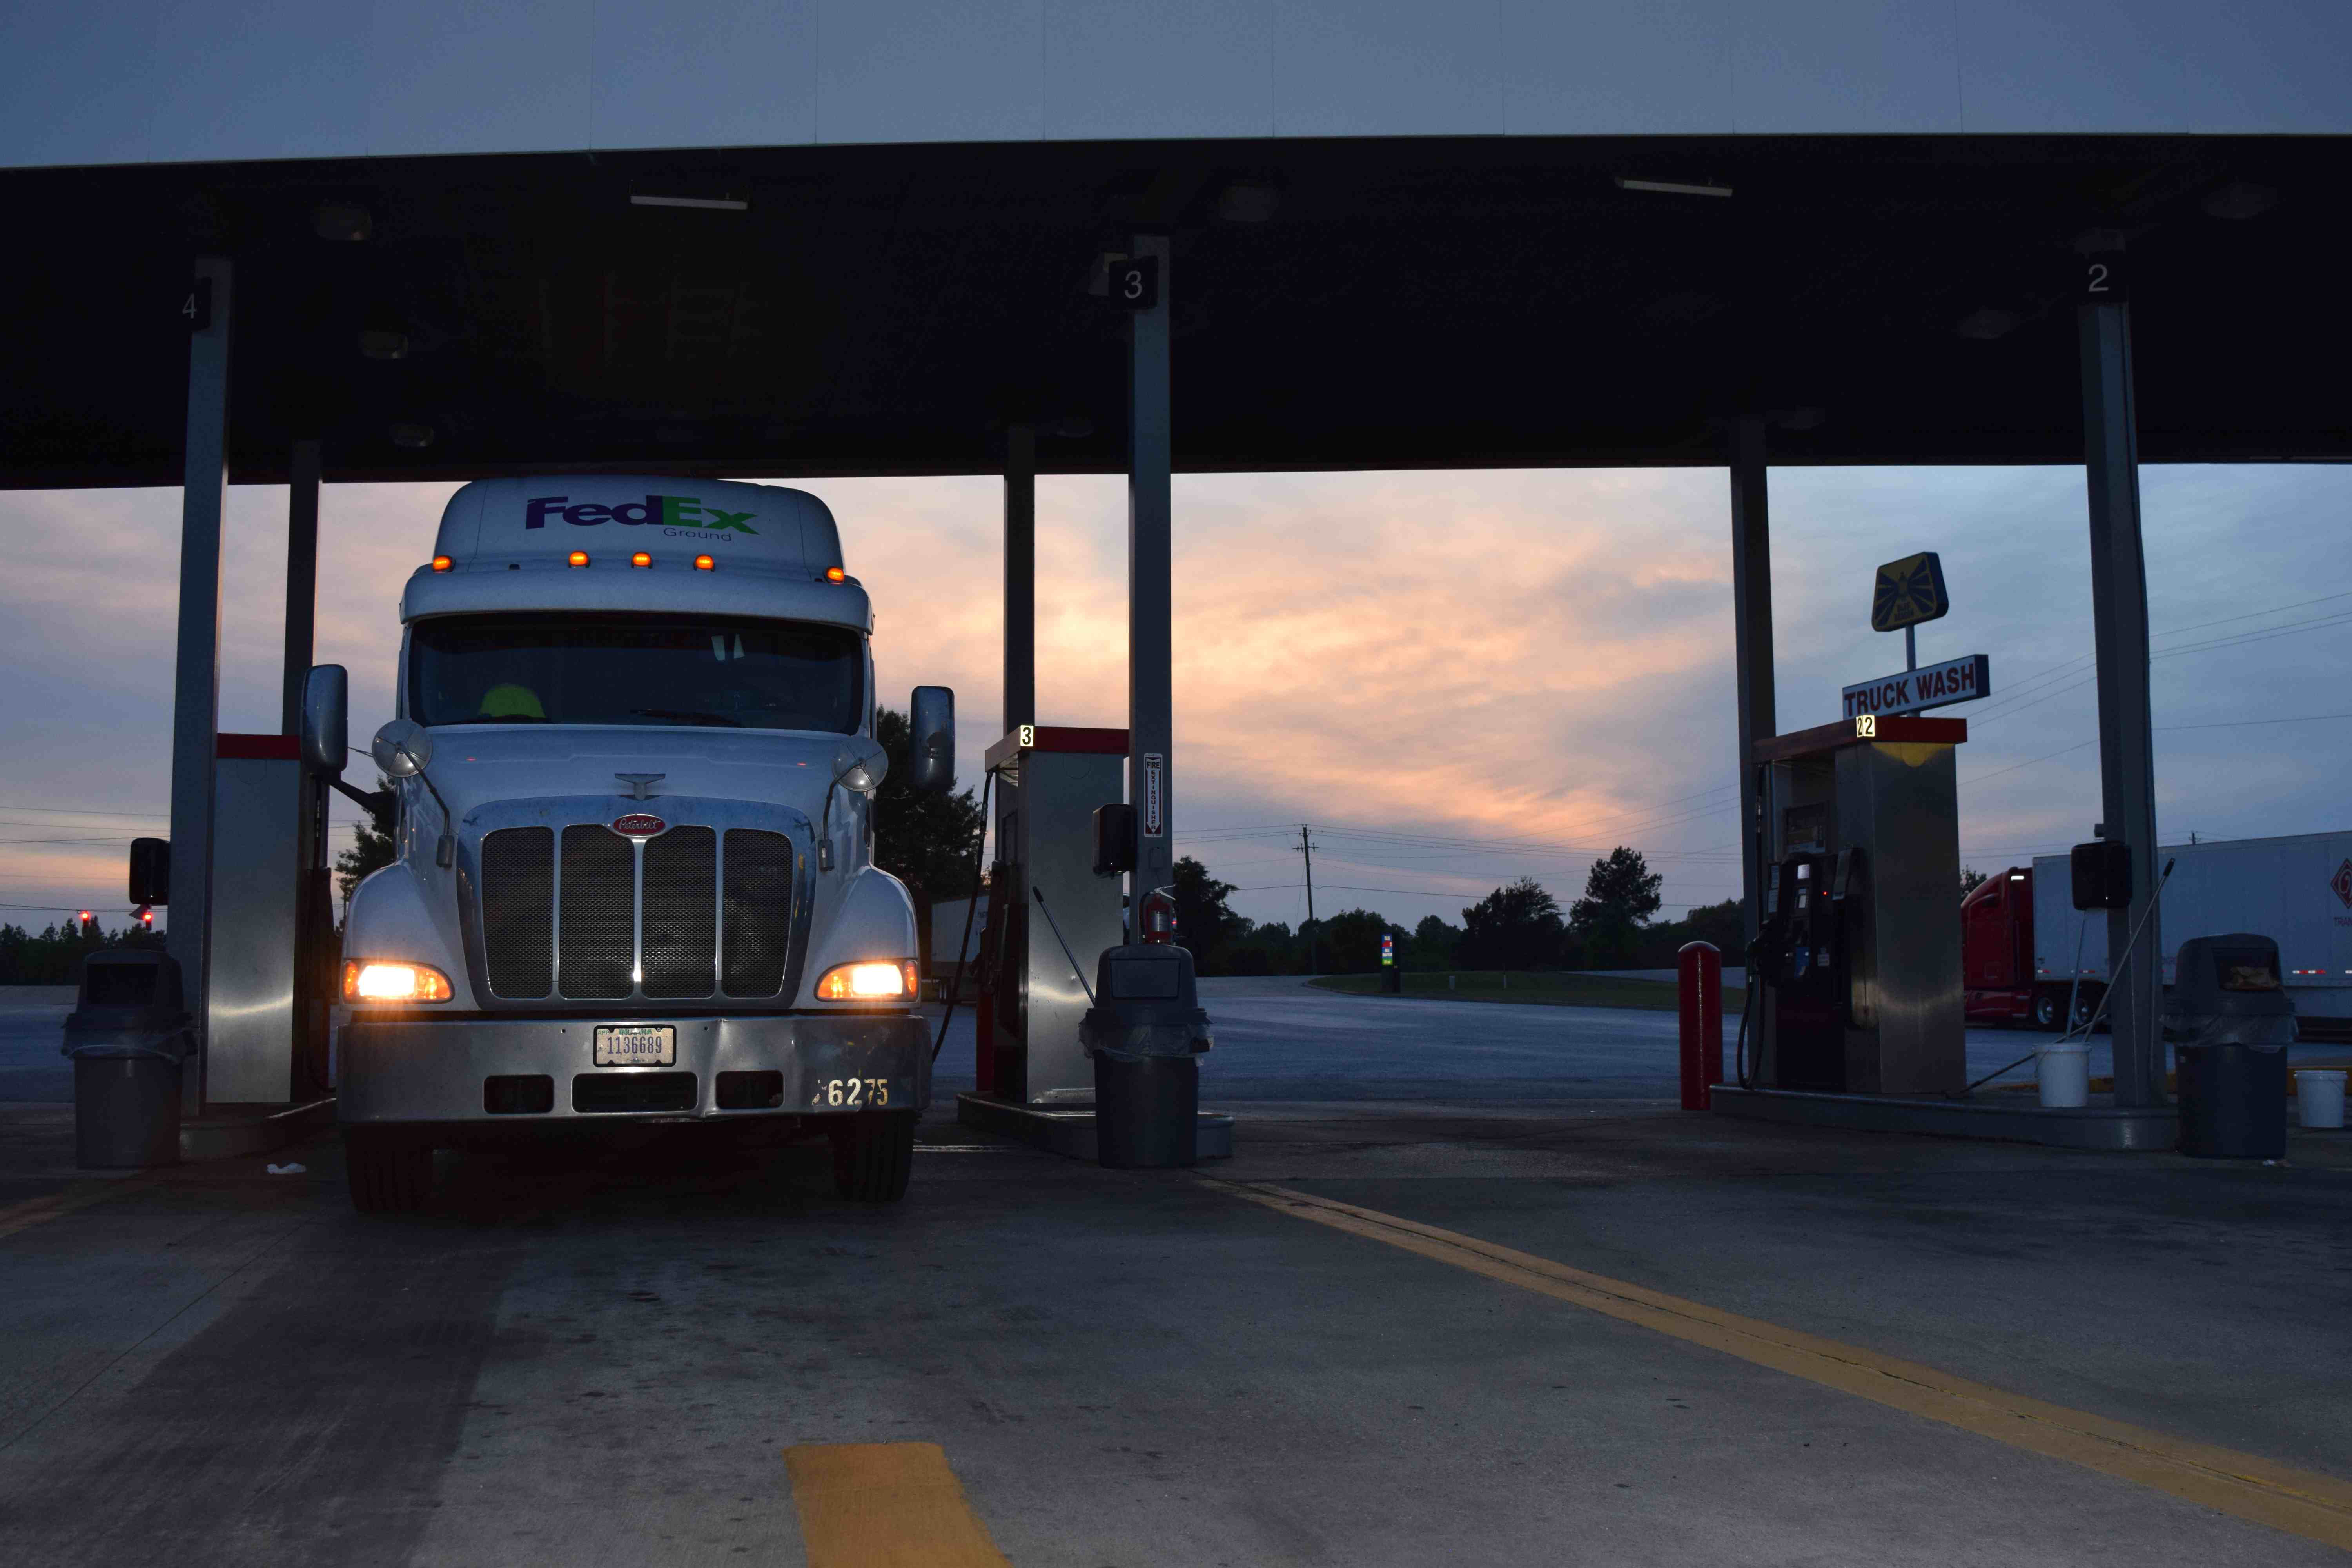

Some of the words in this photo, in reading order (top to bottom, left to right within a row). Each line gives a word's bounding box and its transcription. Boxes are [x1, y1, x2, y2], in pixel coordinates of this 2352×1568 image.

[1125, 270, 1142, 299] 3
[2088, 263, 2109, 292] 2
[181, 292, 197, 319] 4
[526, 495, 760, 535] FedEx
[663, 528, 731, 541] Ground
[1844, 679, 1910, 716] TRUCK
[1916, 663, 1975, 700] WASH
[1022, 727, 1031, 745] 3
[1865, 717, 1873, 734] 2
[619, 818, 661, 830] Peterbilt
[608, 1036, 662, 1054] 1136689
